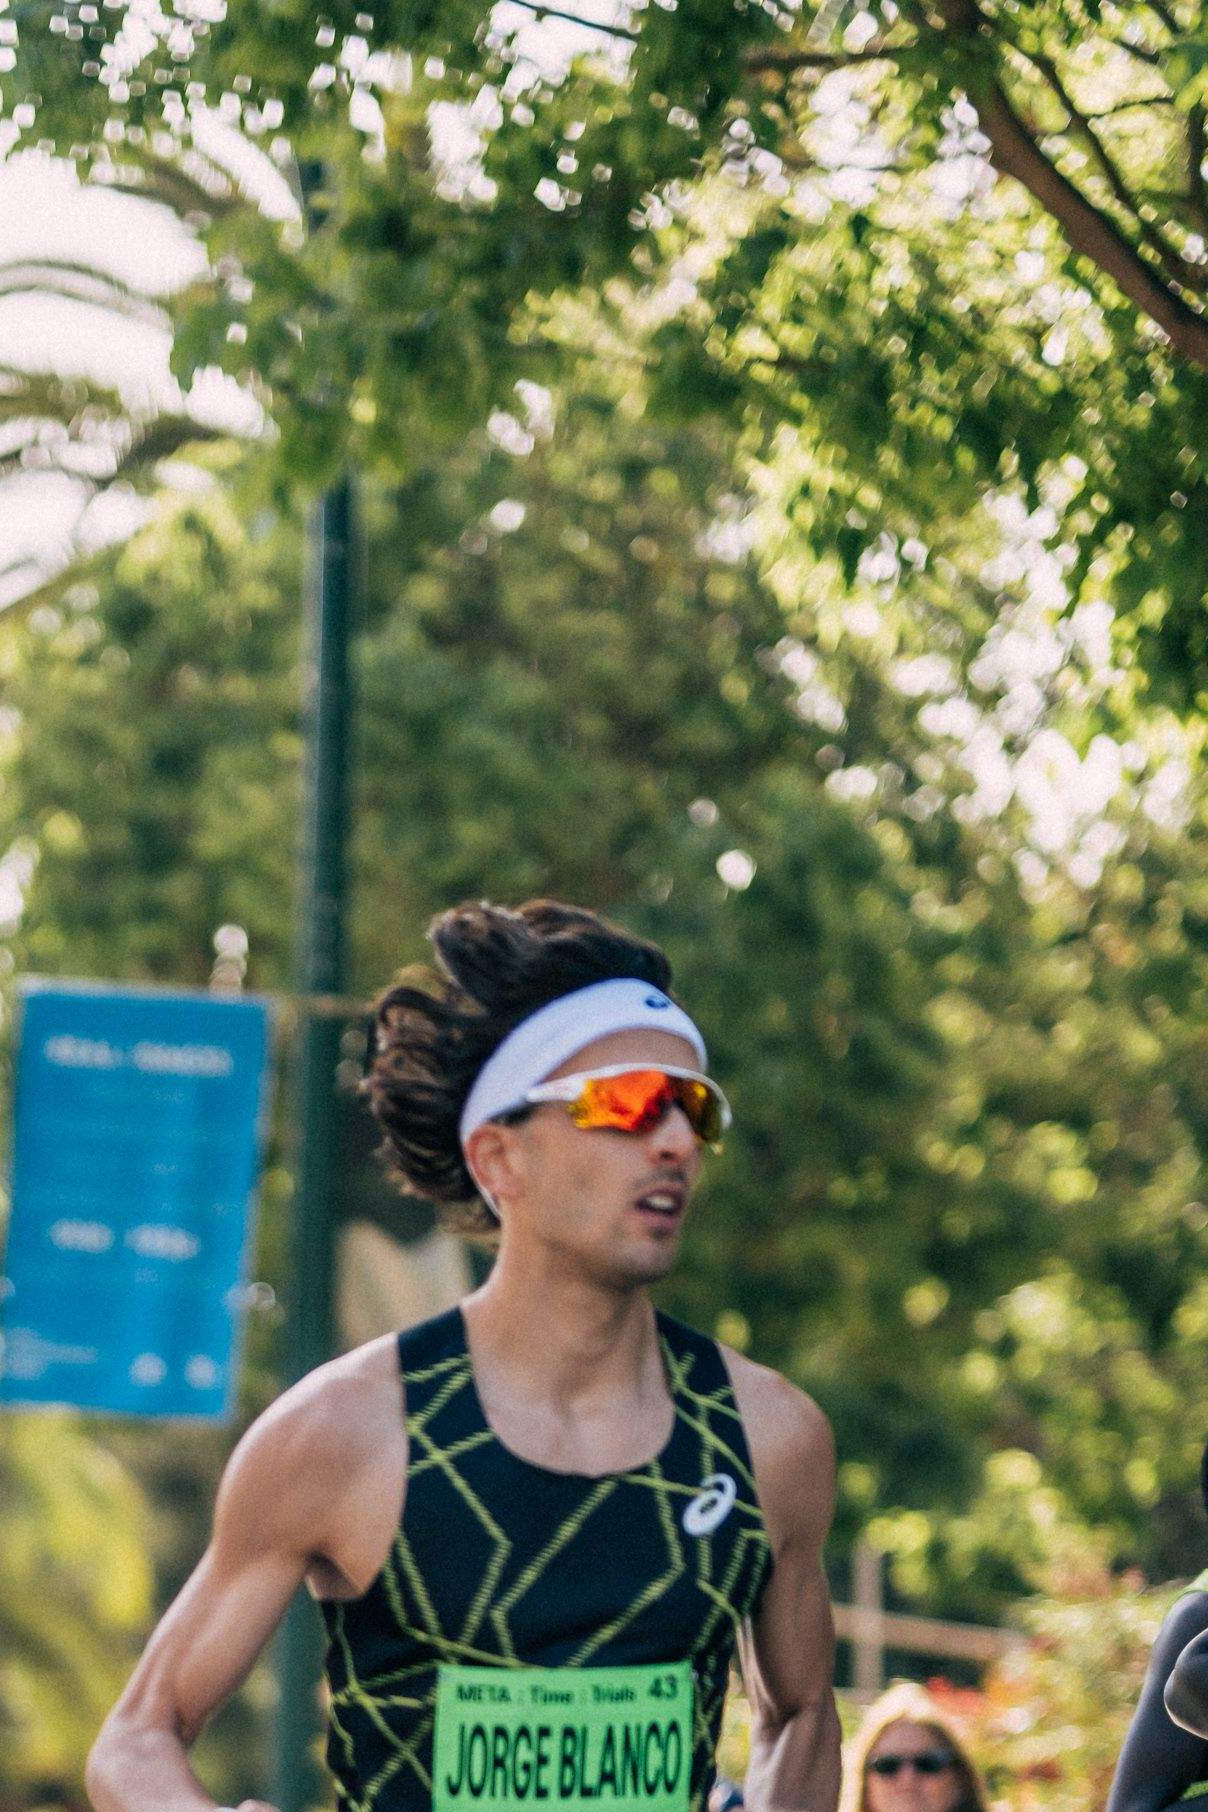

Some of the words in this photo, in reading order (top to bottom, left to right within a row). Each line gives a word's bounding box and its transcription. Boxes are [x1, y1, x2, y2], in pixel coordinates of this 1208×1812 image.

[456, 1684, 512, 1704] META
[649, 1674, 679, 1700] 43
[446, 1722, 551, 1800] JORGE
[559, 1719, 682, 1800] BLANCO
